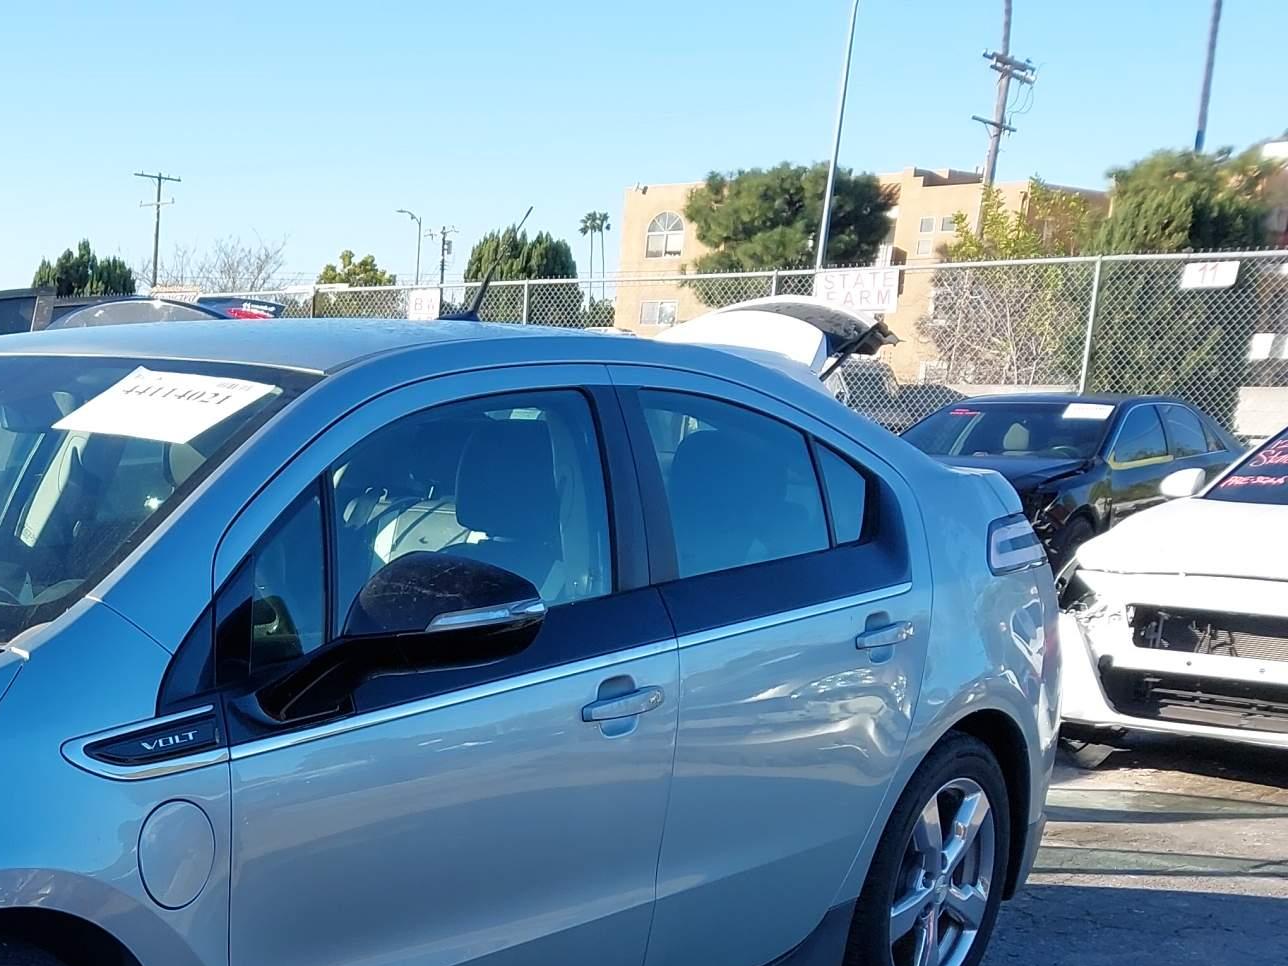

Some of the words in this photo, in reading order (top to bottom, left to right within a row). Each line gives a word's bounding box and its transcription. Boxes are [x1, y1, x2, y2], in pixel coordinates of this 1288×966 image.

[824, 271, 895, 290] STATE
[123, 385, 231, 404] 44114021
[141, 730, 197, 750] VOLT
